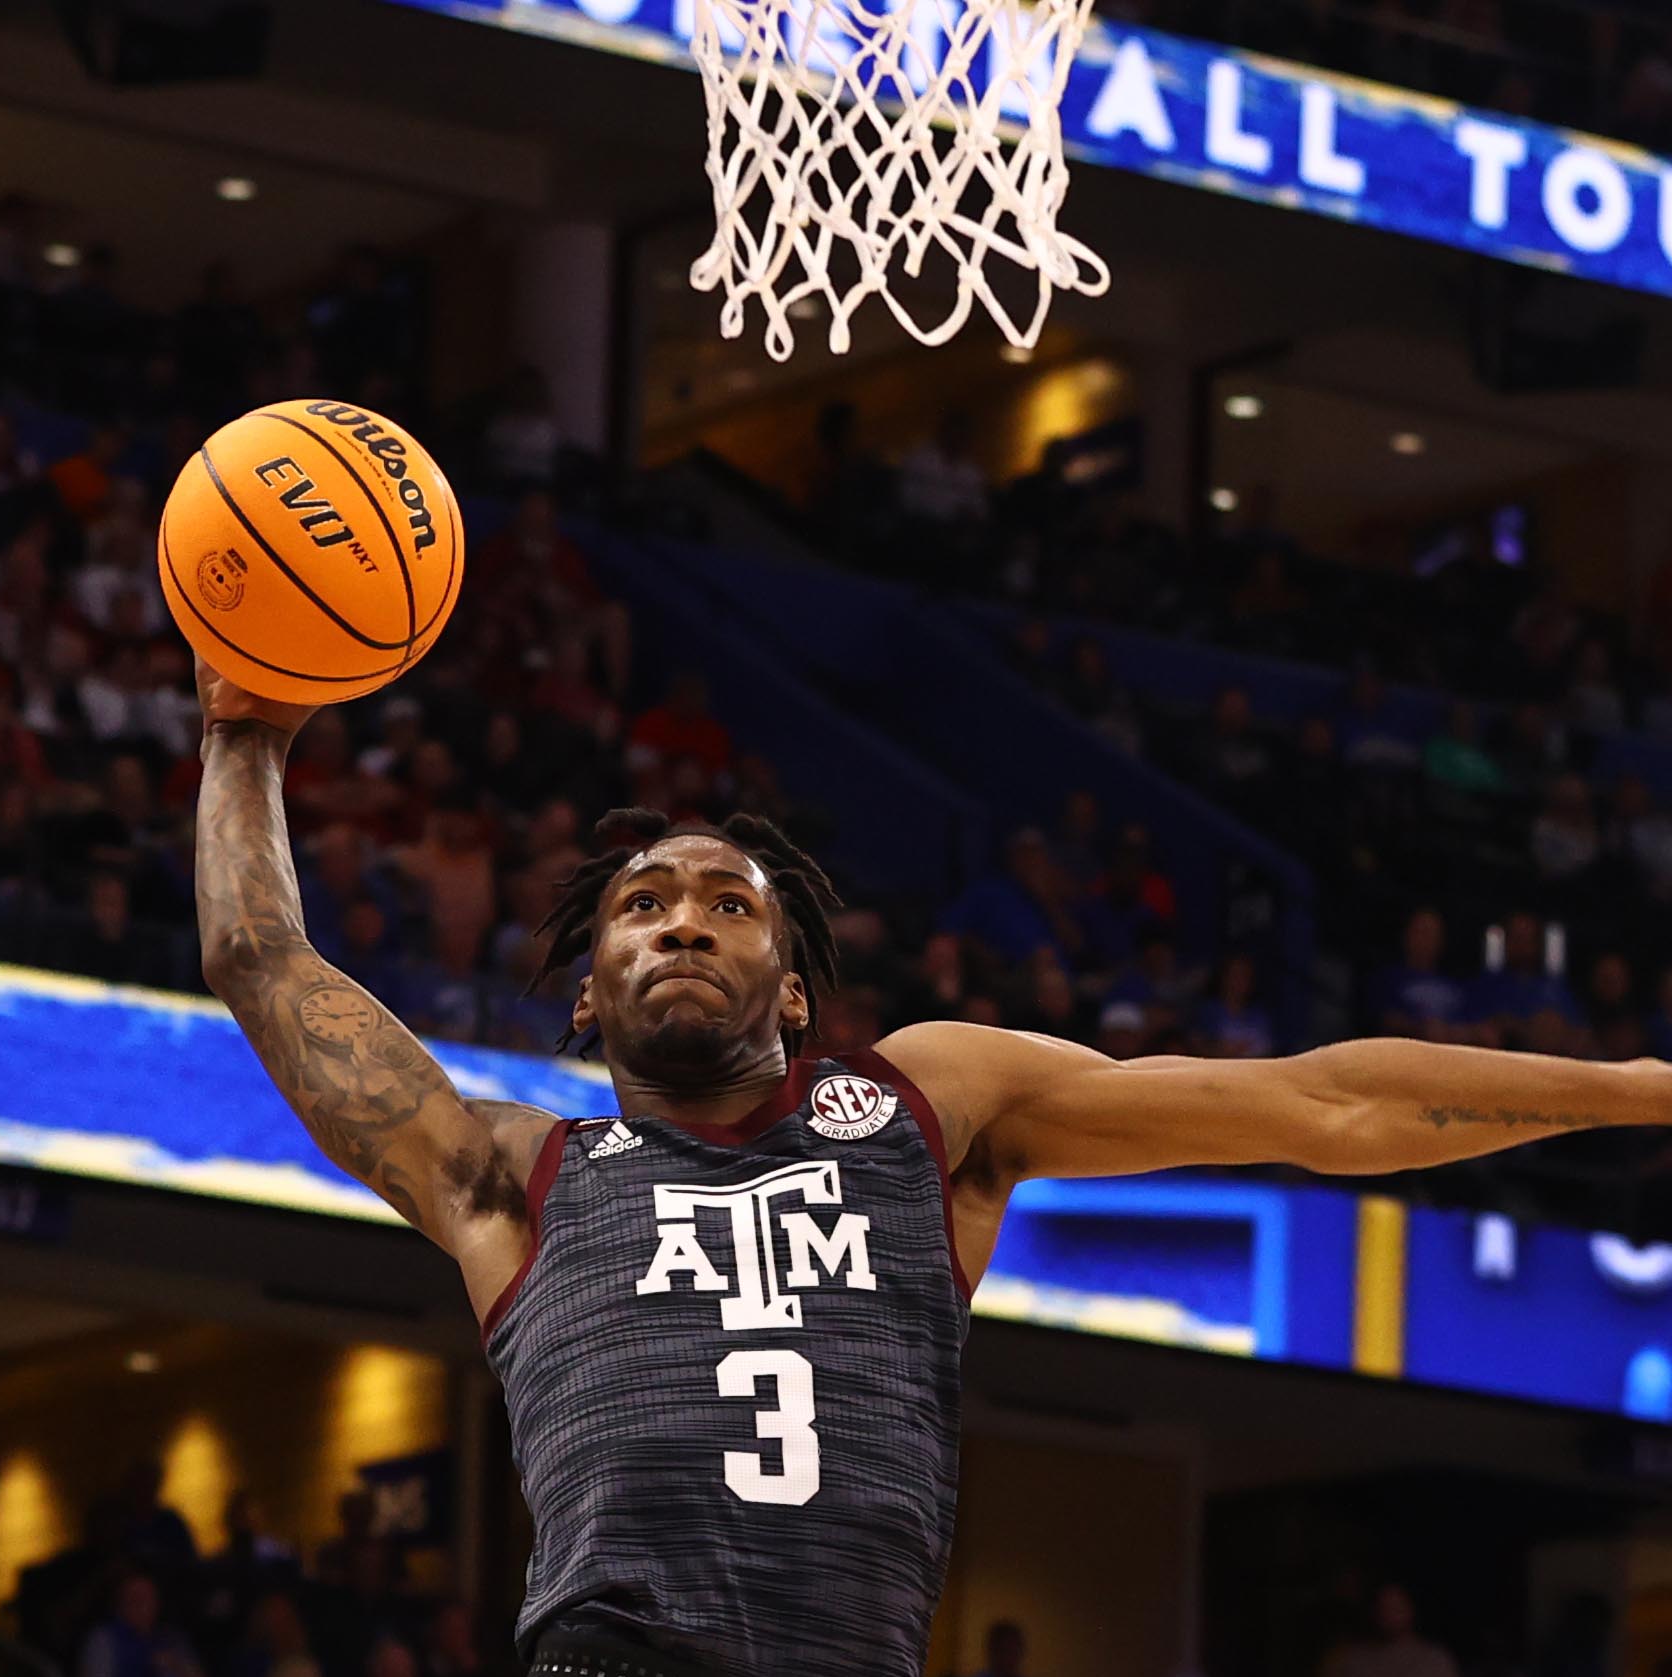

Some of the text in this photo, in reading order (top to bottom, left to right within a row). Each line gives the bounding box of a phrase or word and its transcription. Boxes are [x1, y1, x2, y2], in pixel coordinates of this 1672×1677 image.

[306, 402, 436, 553] Wilson
[348, 542, 378, 574] NXT
[816, 1078, 877, 1122] SEC
[821, 1109, 891, 1138] GRADUATE
[588, 1135, 643, 1159] adidas
[716, 1350, 820, 1506] 3
